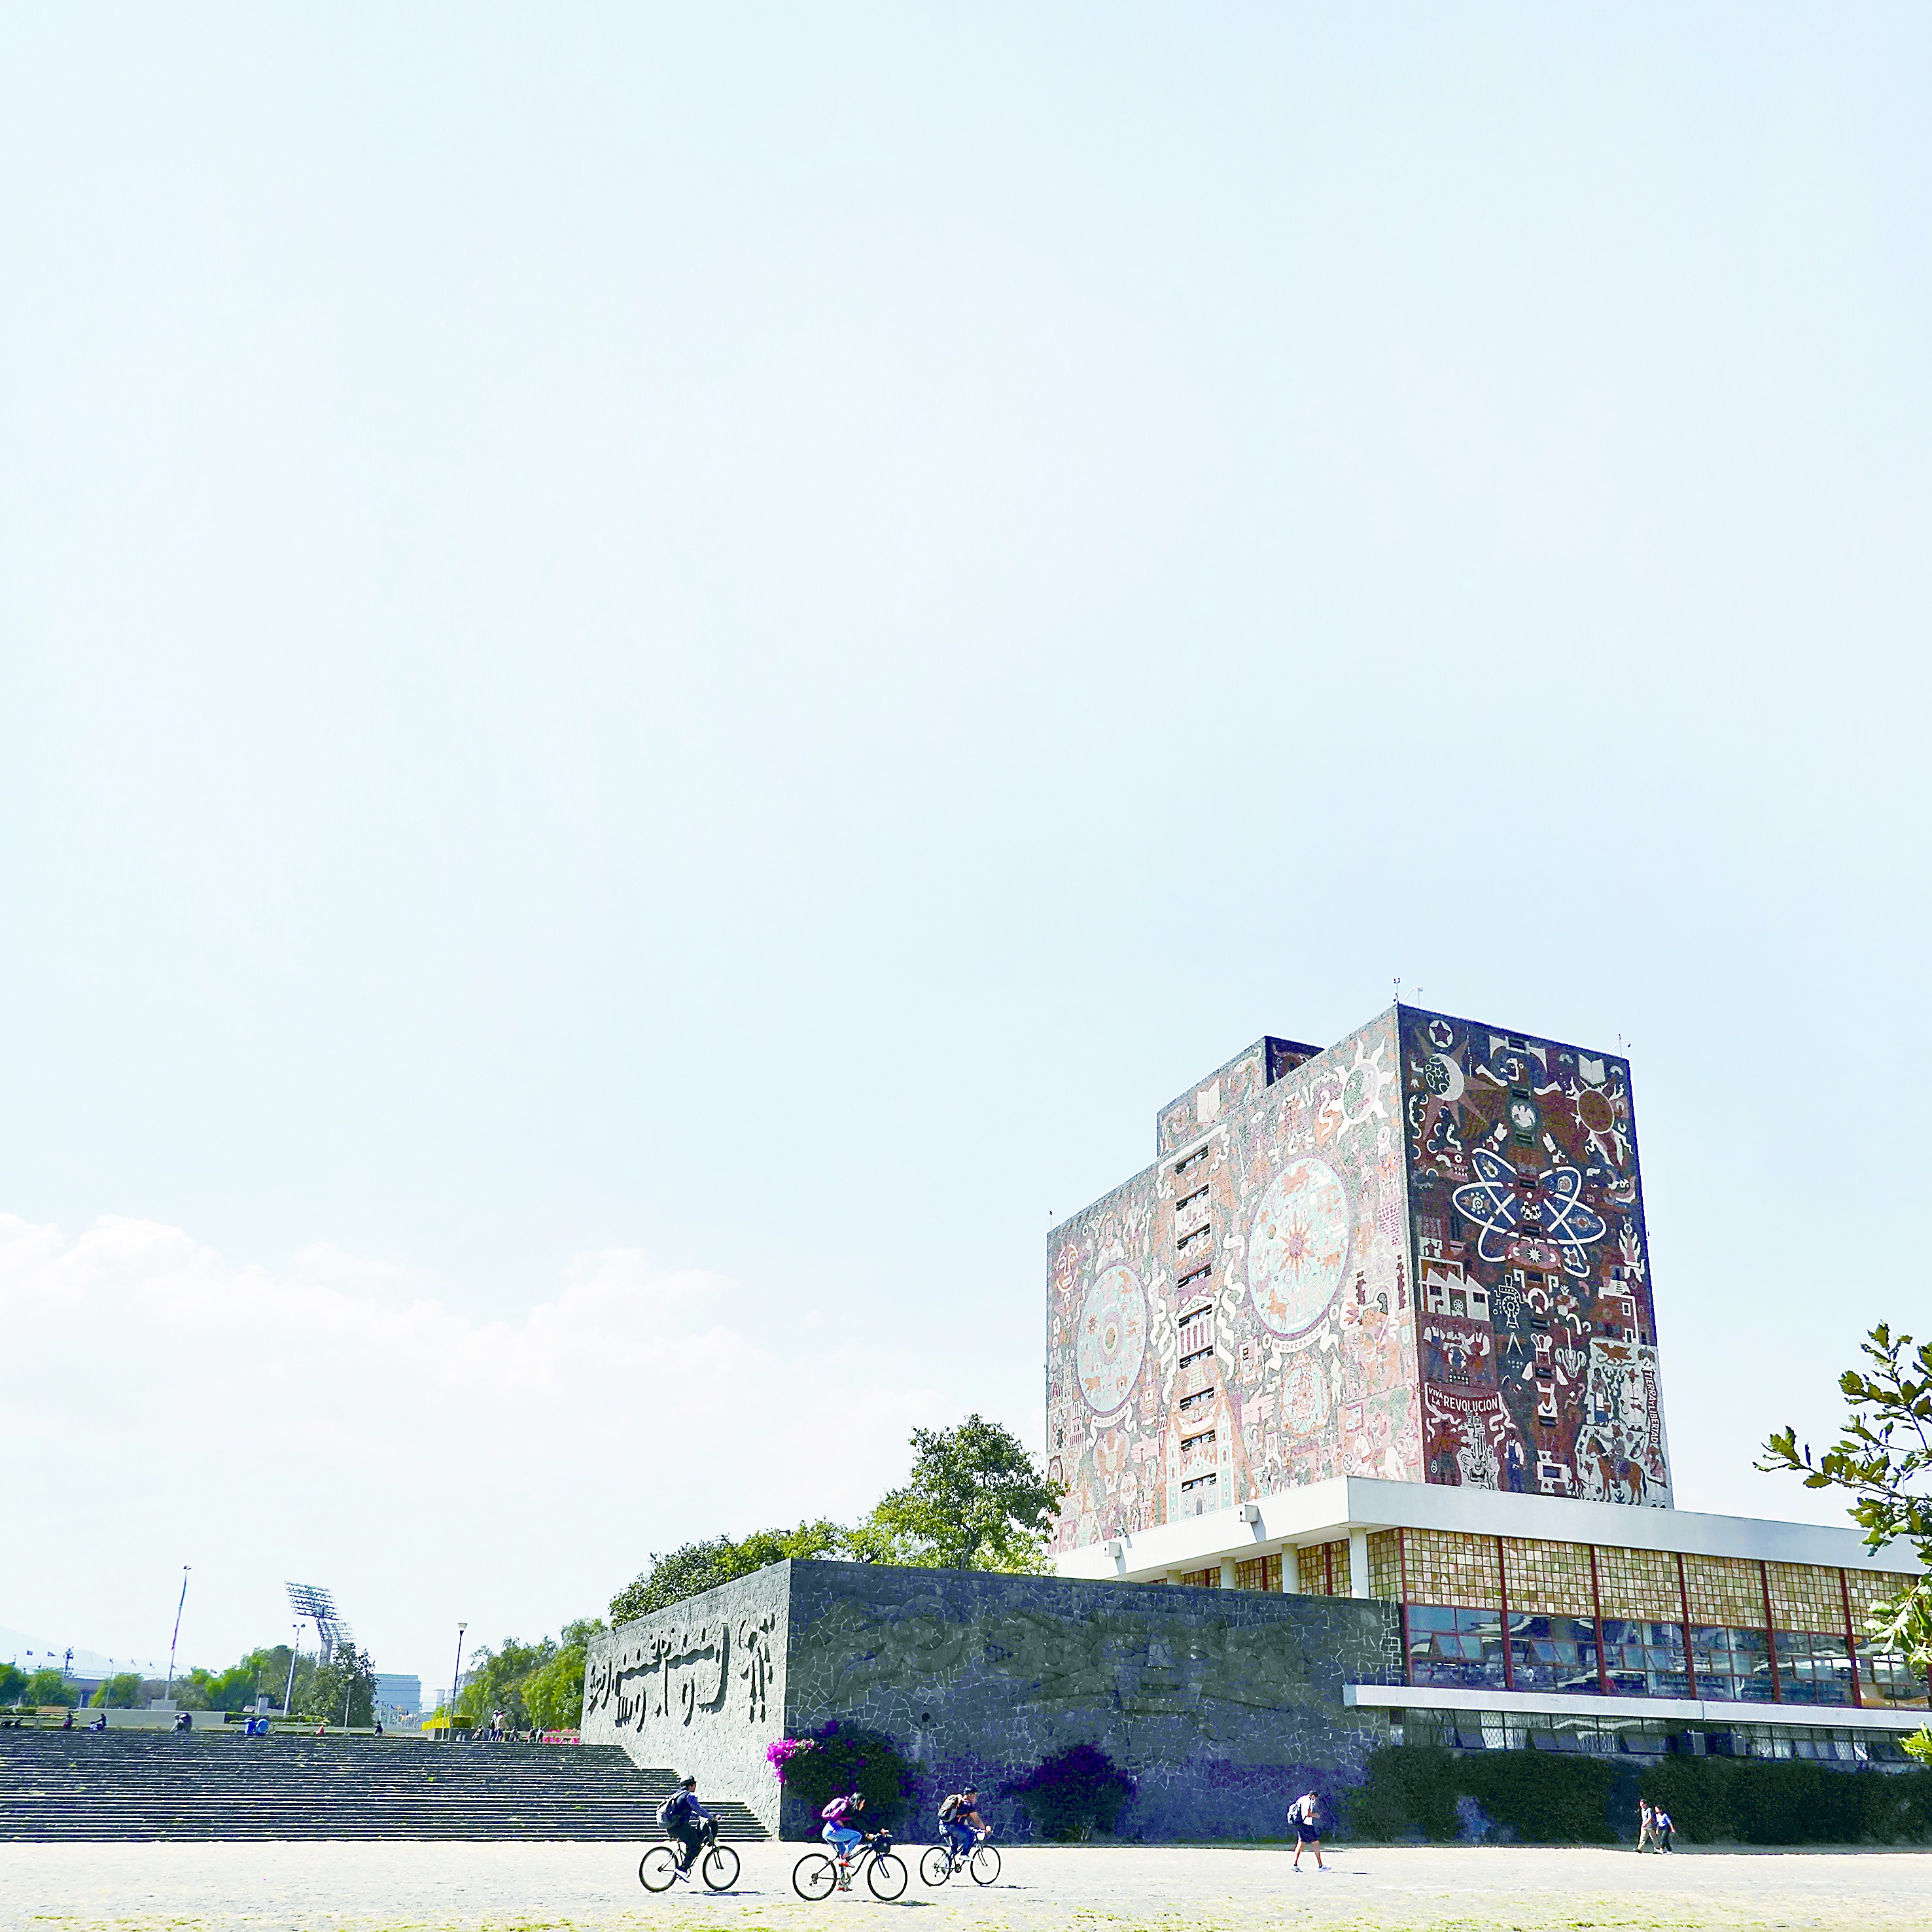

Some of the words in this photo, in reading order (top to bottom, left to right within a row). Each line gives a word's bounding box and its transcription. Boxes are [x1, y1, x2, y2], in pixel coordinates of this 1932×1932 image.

[1281, 1330, 1319, 1350] COPERNICO
[1428, 1387, 1443, 1399] VIVA
[1644, 1371, 1657, 1401] TIERRA
[1431, 1396, 1441, 1406] LA
[1443, 1395, 1498, 1413] REVOLUCION
[1098, 1409, 1125, 1426] PTOLOMEO
[1648, 1405, 1659, 1443] LIBERTAD
